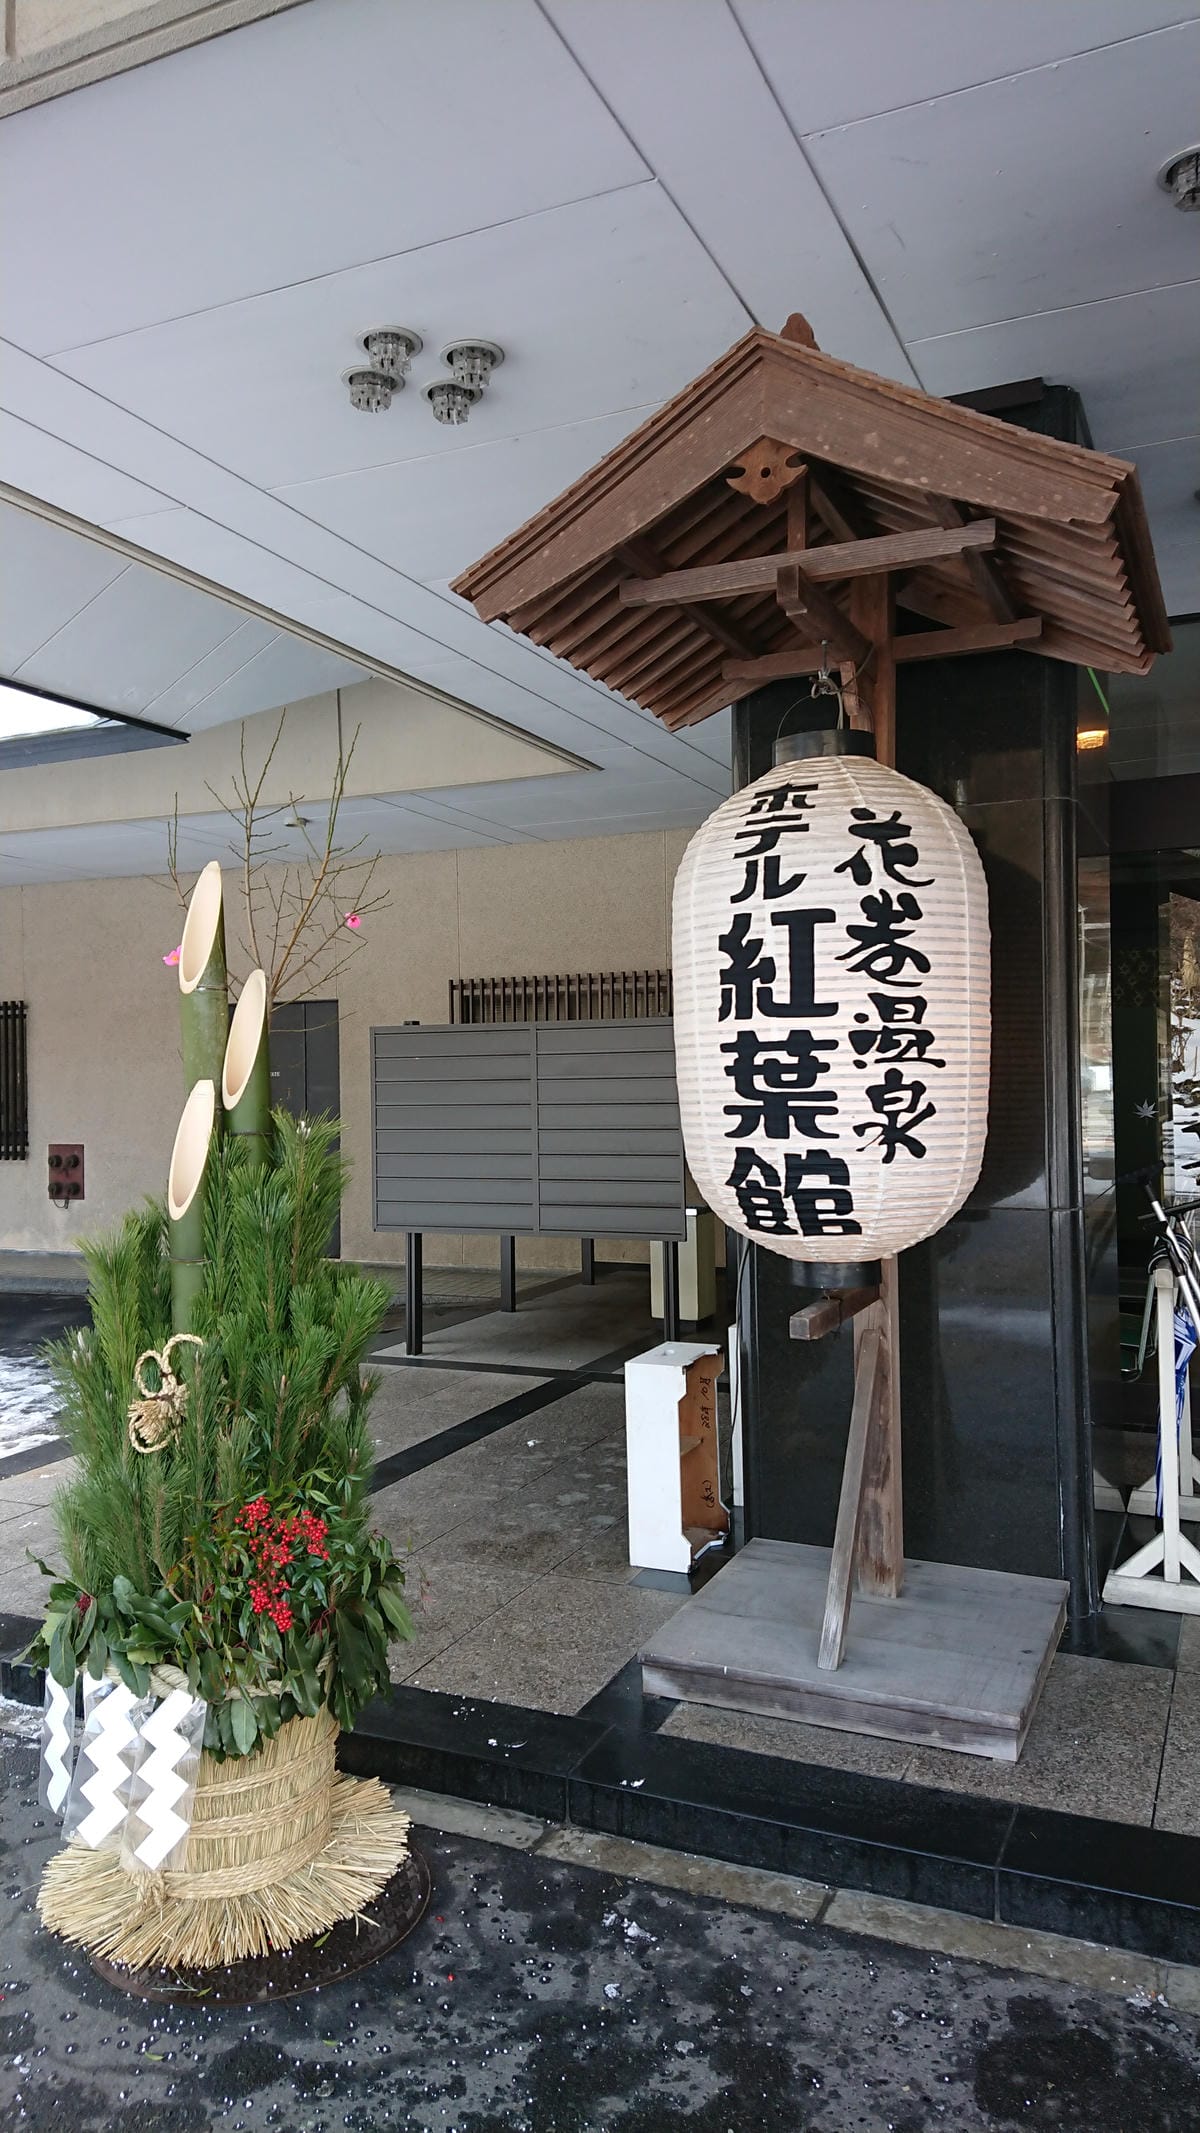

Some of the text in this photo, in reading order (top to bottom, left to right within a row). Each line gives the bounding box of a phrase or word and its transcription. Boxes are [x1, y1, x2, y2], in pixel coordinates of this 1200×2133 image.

[718, 783, 862, 1237] ホテル紅葉館
[834, 807, 945, 1163] 花巻温泉
